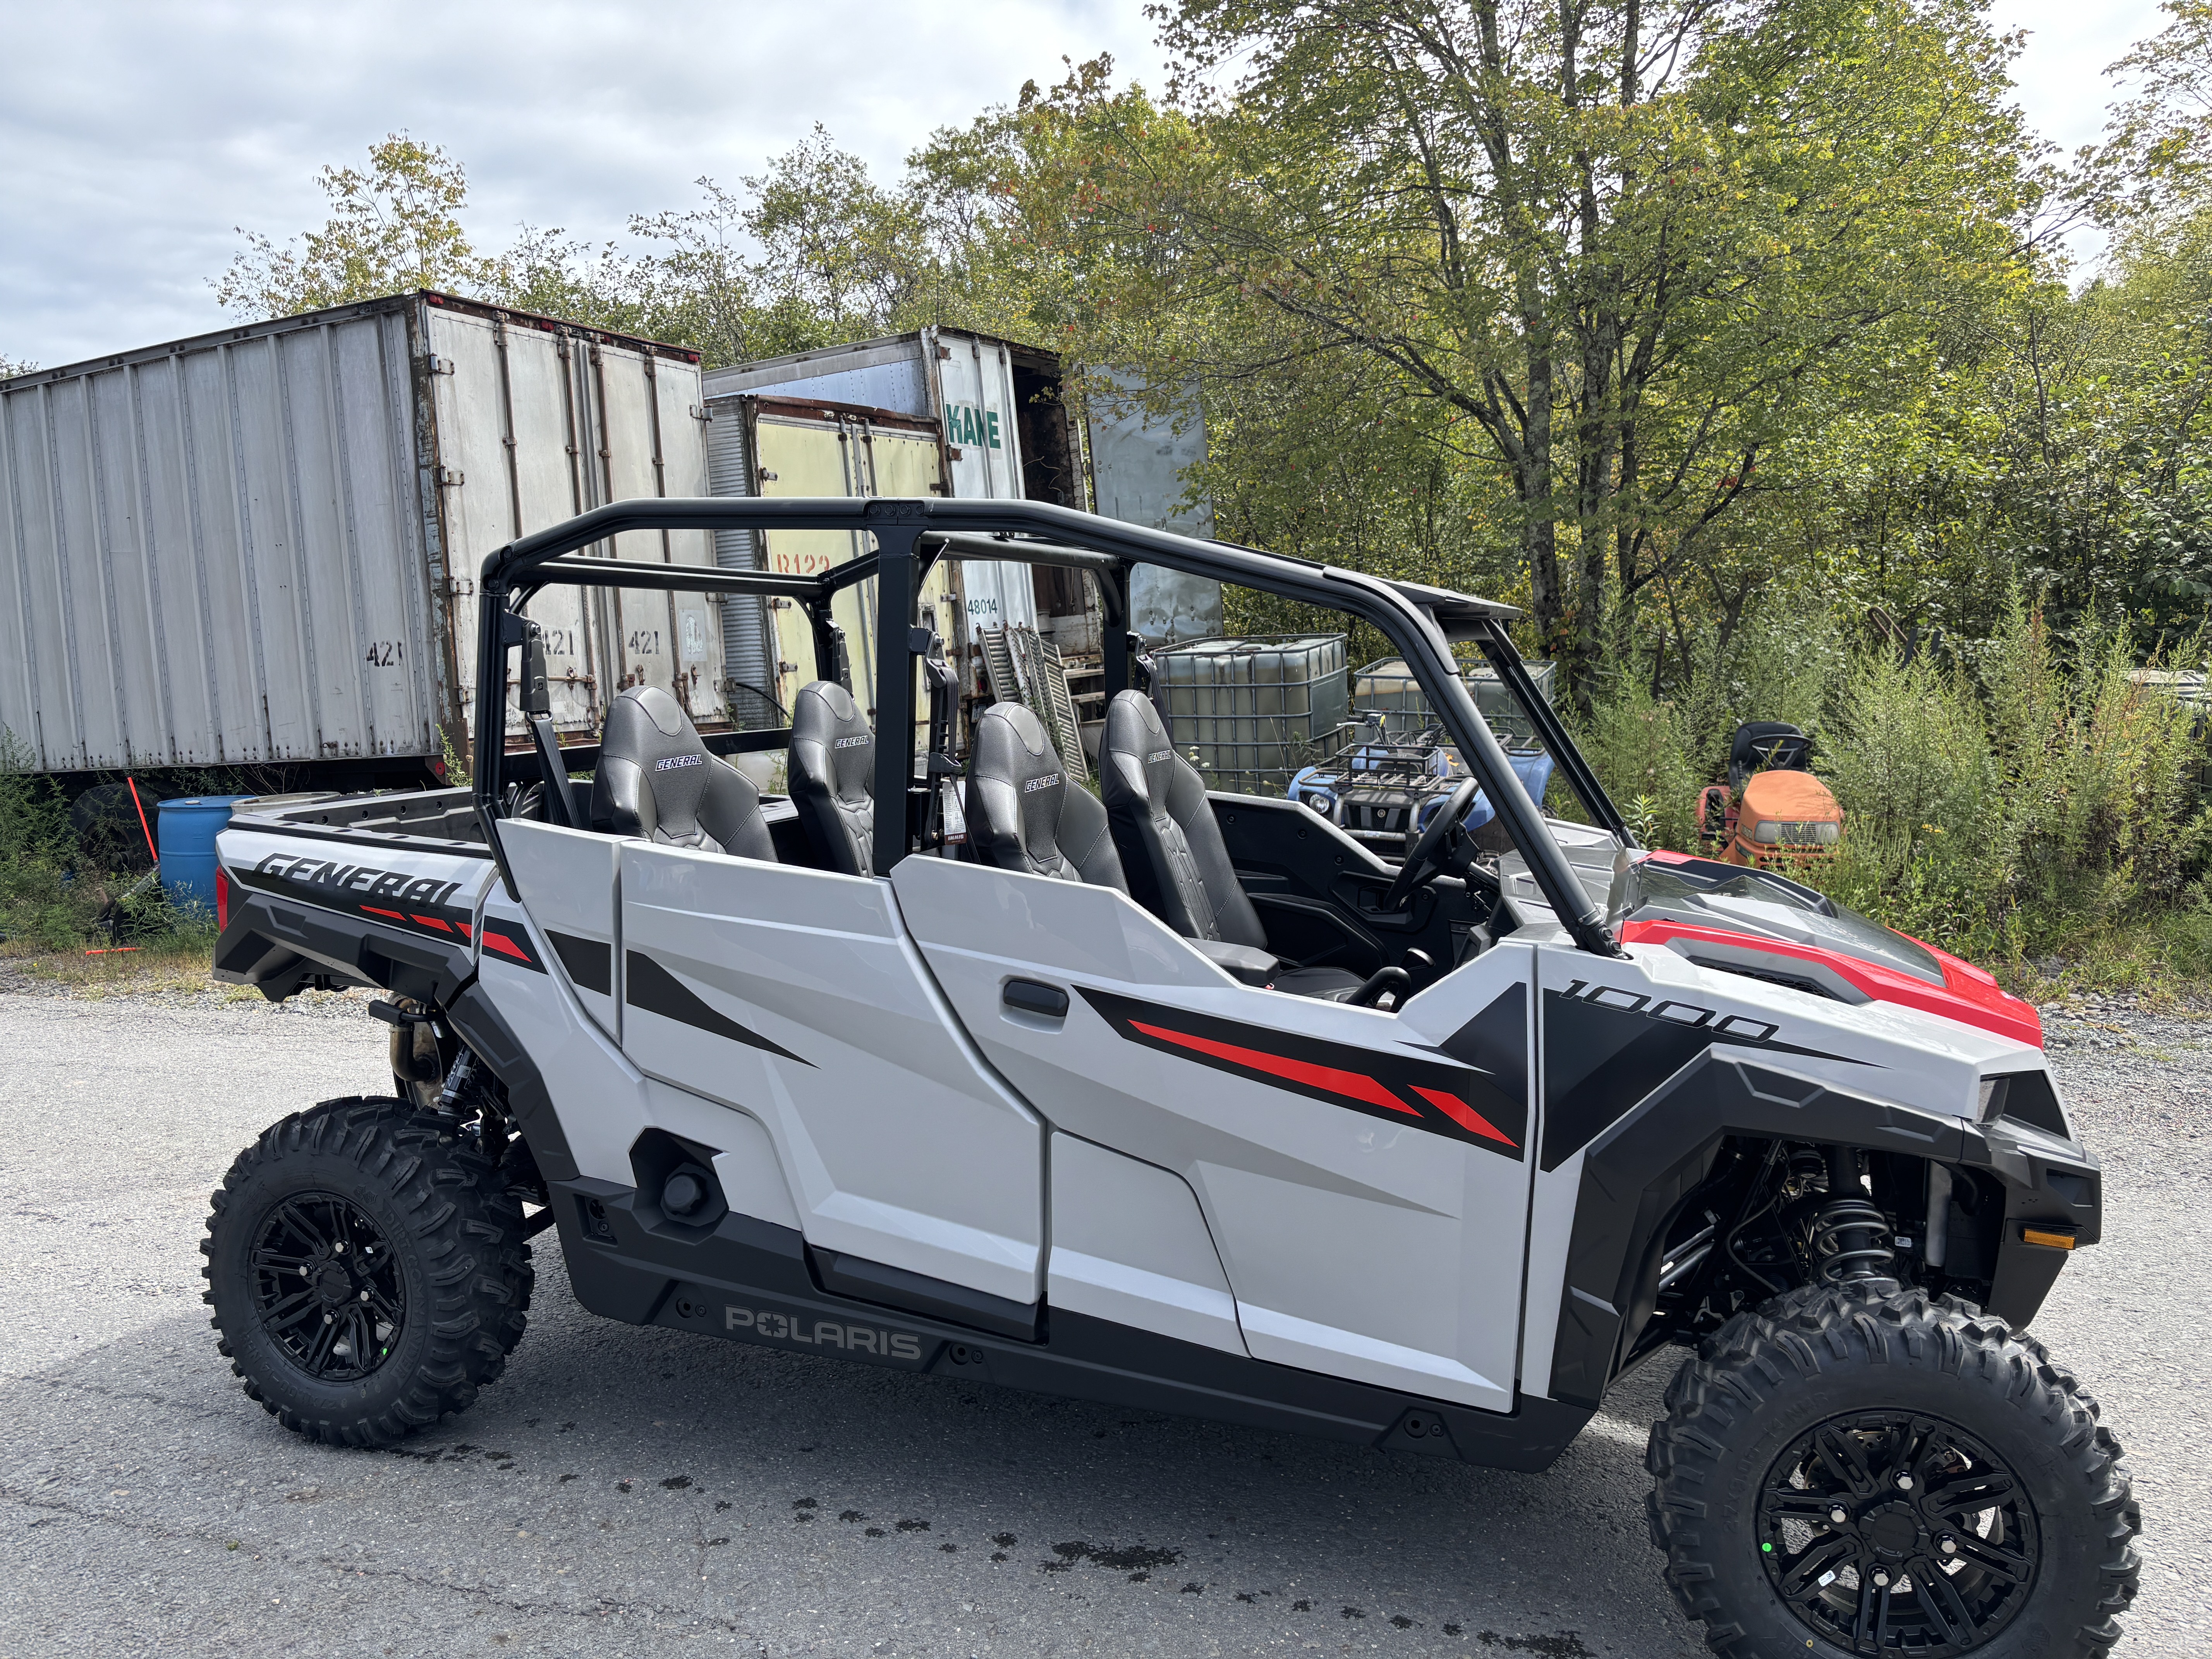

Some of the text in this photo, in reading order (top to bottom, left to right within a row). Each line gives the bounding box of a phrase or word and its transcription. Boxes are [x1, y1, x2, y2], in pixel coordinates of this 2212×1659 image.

[946, 404, 1001, 449] KANE
[968, 598, 998, 615] 48014
[629, 630, 659, 654] 421
[367, 642, 403, 667] 421
[835, 735, 869, 749] GENERAL
[655, 754, 702, 772] GENERAL
[1148, 750, 1171, 764] GENERAL
[1024, 773, 1059, 793] GENERAL
[252, 853, 463, 909] GENERAL
[1559, 979, 1779, 1042] 1000
[724, 1304, 922, 1360] POLARIS
